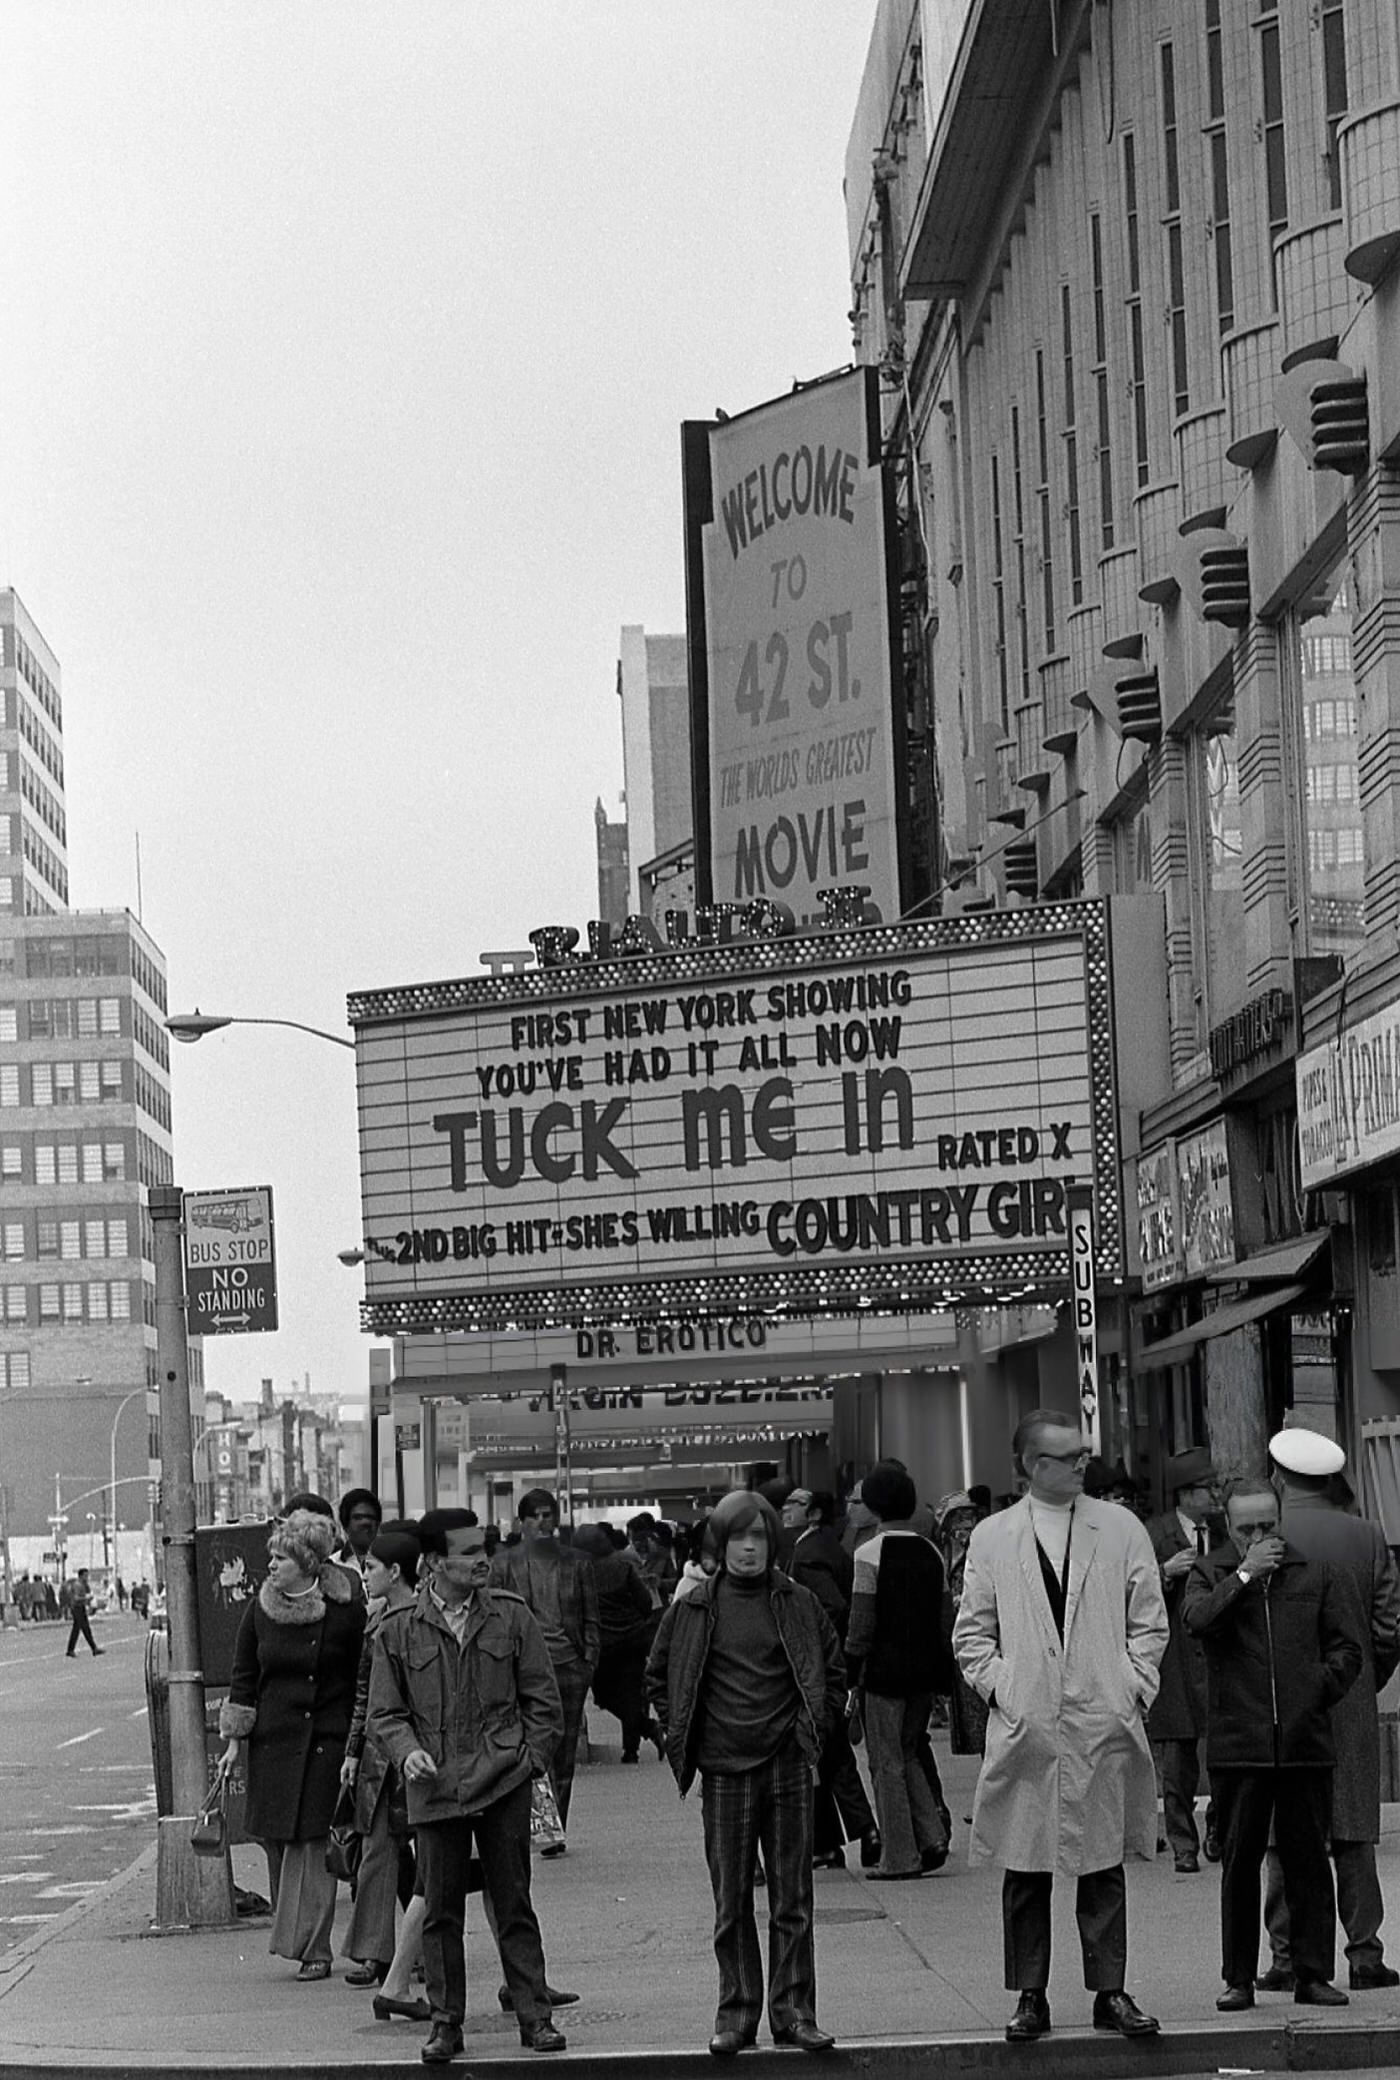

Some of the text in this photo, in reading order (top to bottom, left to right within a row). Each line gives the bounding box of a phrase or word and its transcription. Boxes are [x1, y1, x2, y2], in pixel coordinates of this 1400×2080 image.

[722, 445, 858, 561] WELCOME
[771, 554, 807, 609] TO
[735, 611, 861, 726] 42 ST.
[720, 727, 876, 808] THE WORLDS GREATEST
[735, 799, 869, 899] MOVIE
[529, 897, 796, 969] RIALTO
[511, 970, 911, 1050] FIRST NEW YORK SHOWING
[476, 1016, 901, 1100] YOU'VE HAD IT ALL NOW
[433, 1096, 640, 1192] TUCK
[938, 1122, 1073, 1170] RATED X
[191, 1239, 269, 1263] BUS STOP
[395, 1229, 449, 1265] 2ND
[452, 1223, 496, 1260] BIG
[647, 1201, 760, 1243] WILLING
[767, 1184, 980, 1256] COUNTRY
[988, 1176, 1075, 1239] GIR
[198, 1288, 265, 1312] STANDING
[212, 1267, 249, 1288] NO
[577, 1329, 620, 1358] DR.
[1075, 1224, 1096, 1435] SUBWAY
